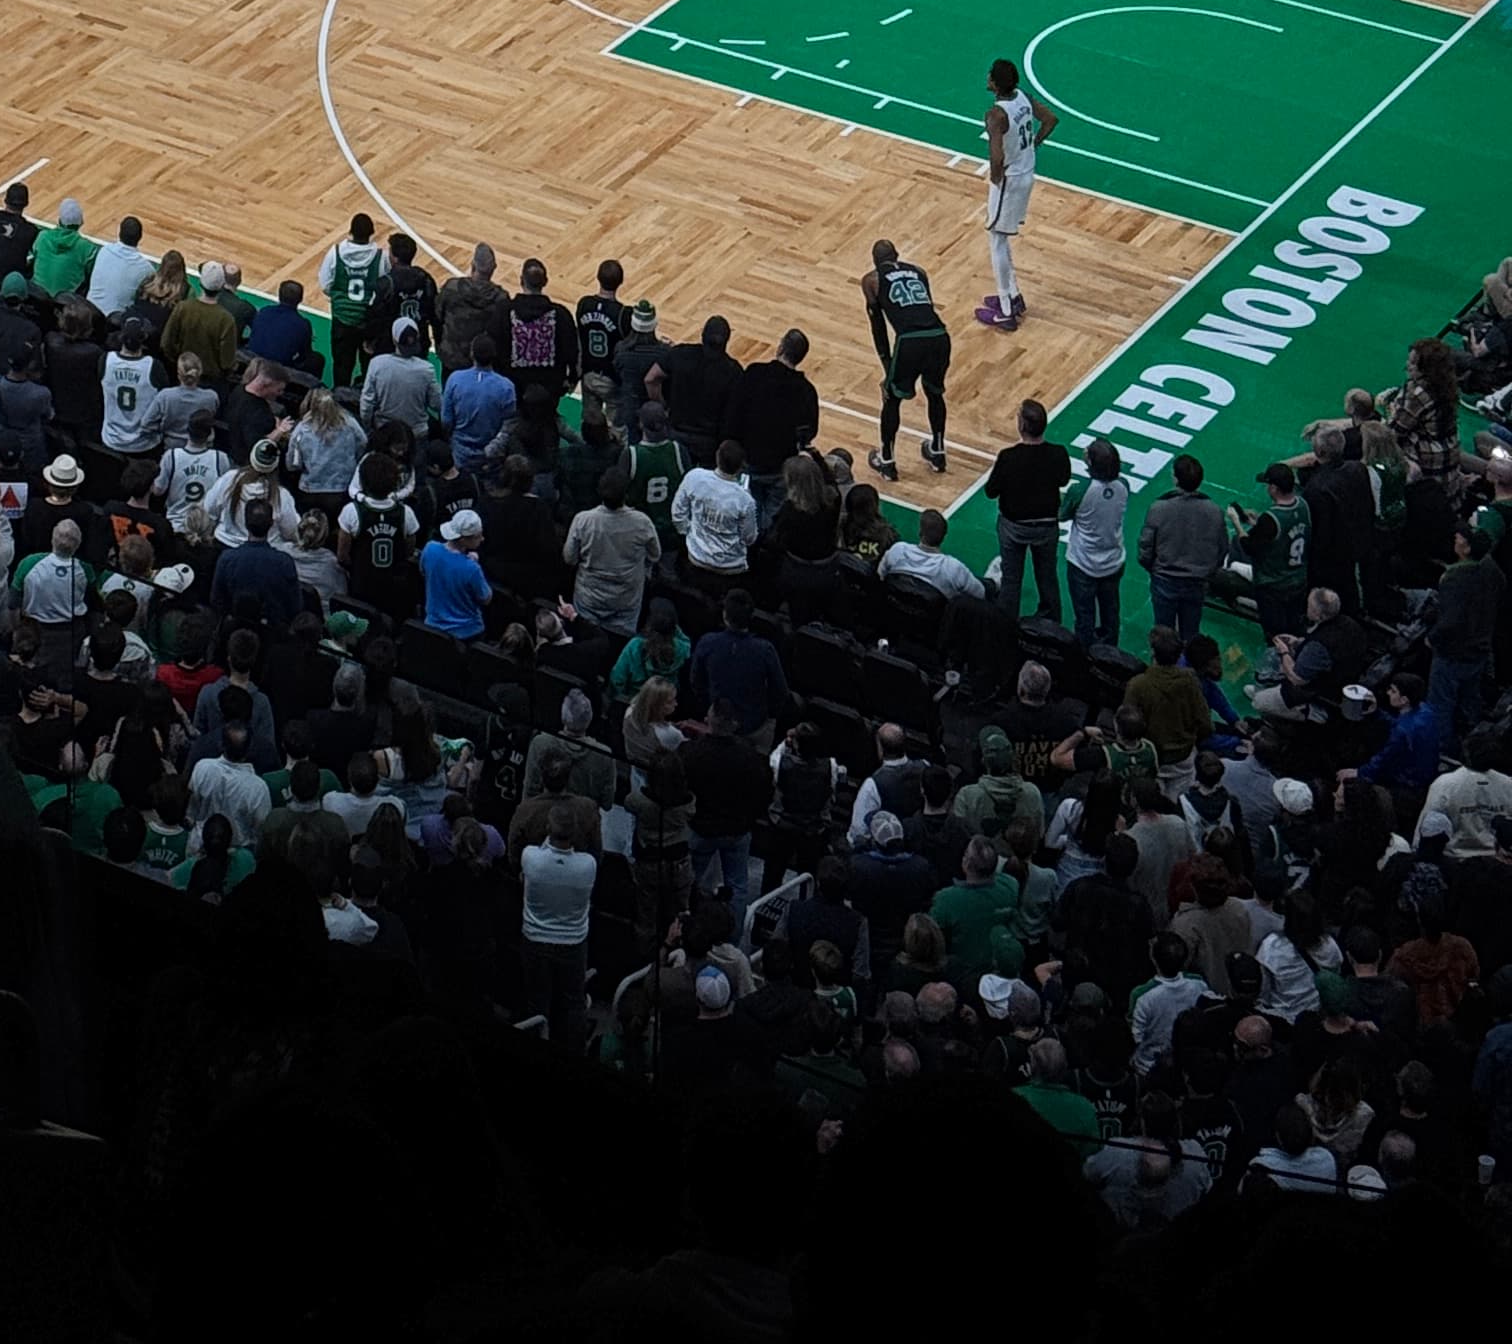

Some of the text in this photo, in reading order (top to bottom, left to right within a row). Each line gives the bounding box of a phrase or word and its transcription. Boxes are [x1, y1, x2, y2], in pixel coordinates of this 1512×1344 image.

[1181, 184, 1426, 366] BOSTON
[889, 278, 930, 307] 42
[588, 329, 609, 358] 8
[117, 385, 136, 412] 0
[372, 538, 393, 568] 0
